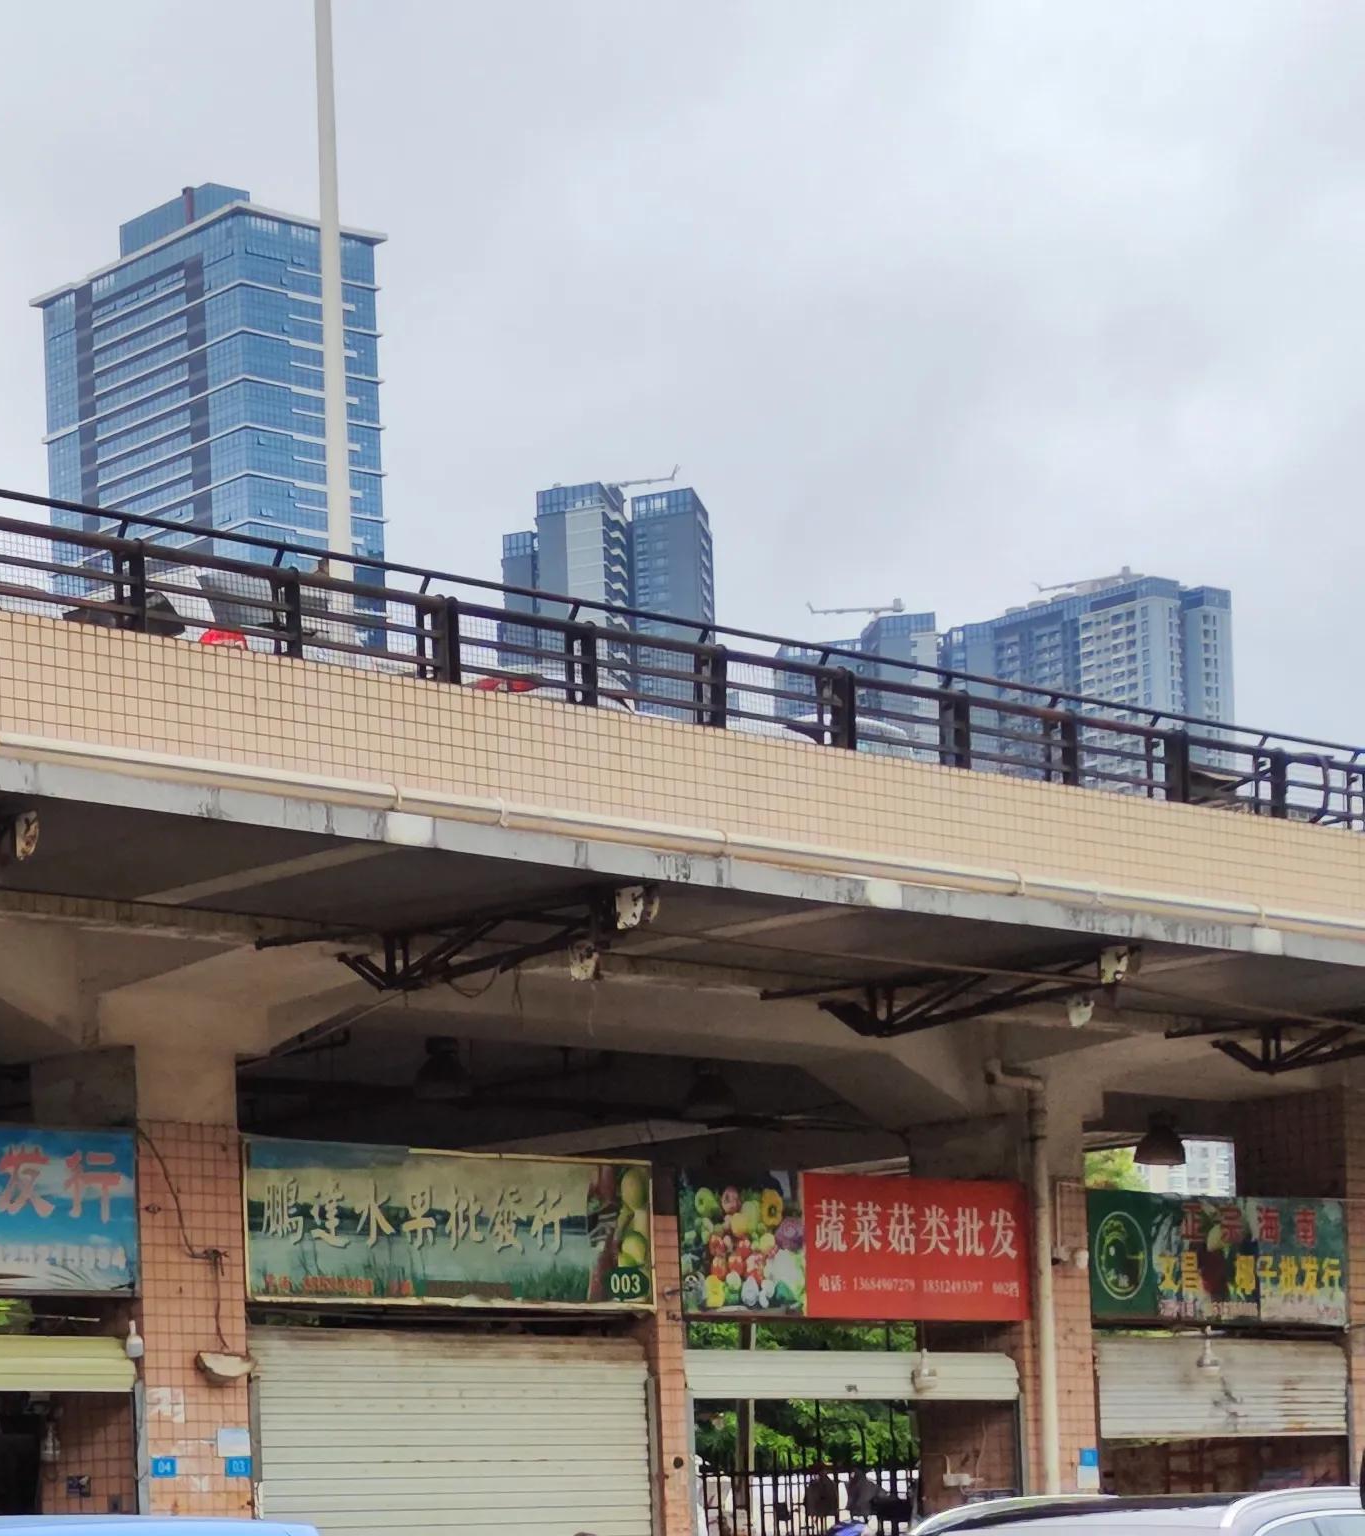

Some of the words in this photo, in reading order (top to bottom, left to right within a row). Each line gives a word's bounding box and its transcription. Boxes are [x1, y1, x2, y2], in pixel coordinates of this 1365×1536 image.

[814, 1199, 1019, 1260] 蔬菜菇类批发
[609, 1275, 642, 1295] 003
[157, 1460, 172, 1474] 04
[231, 1460, 246, 1474] 03
